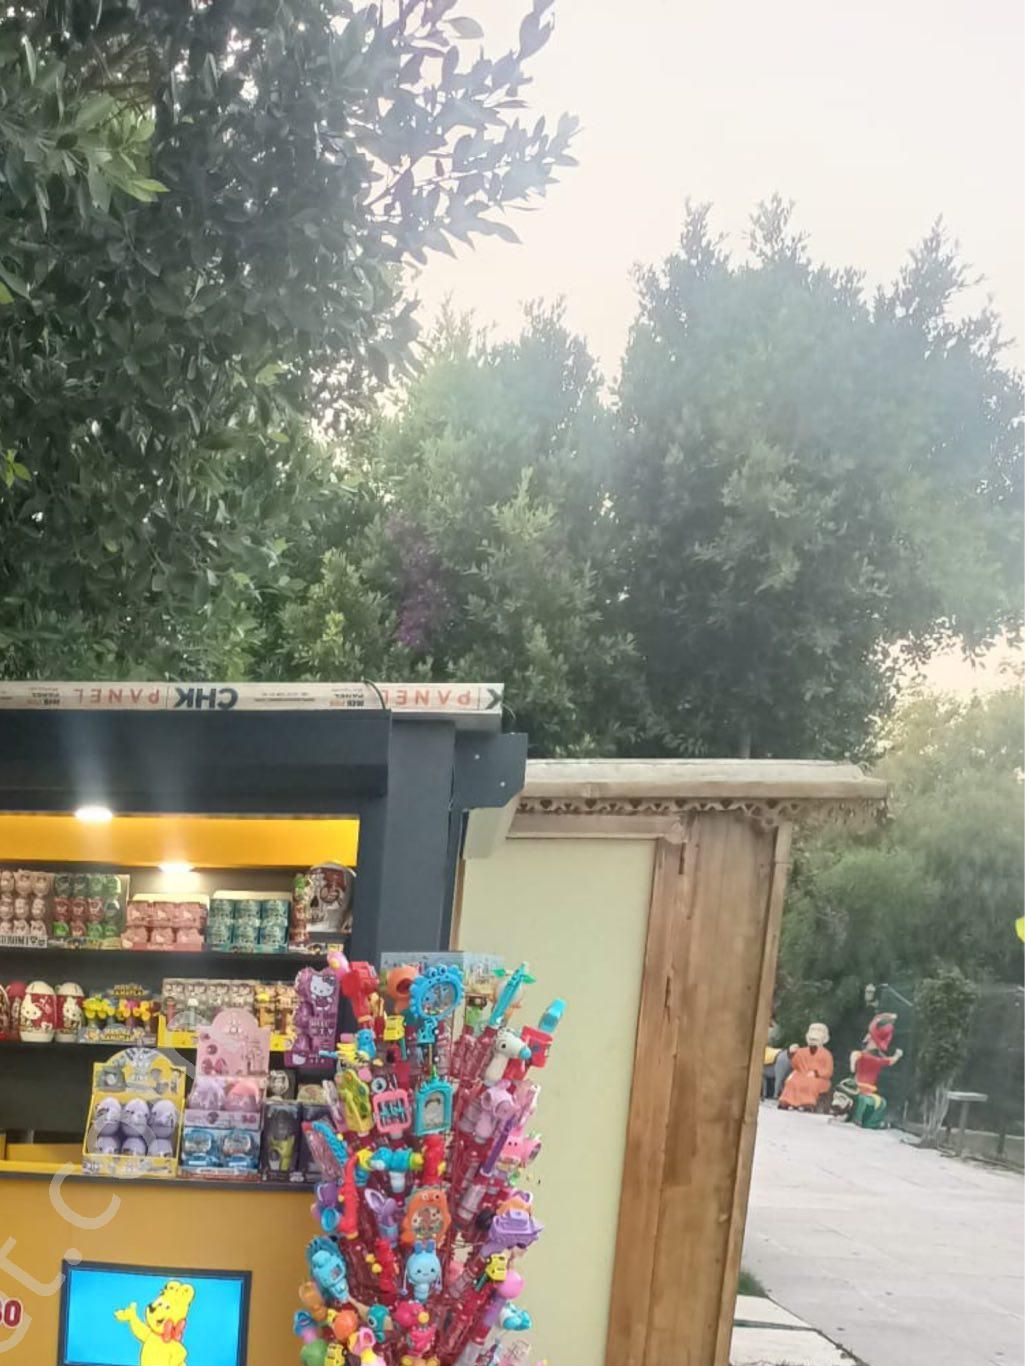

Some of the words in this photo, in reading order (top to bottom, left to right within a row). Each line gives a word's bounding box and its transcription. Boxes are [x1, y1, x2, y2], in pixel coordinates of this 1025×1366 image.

[73, 687, 160, 705] PANEL
[174, 687, 239, 709] CHK
[382, 689, 471, 706] PANEL
